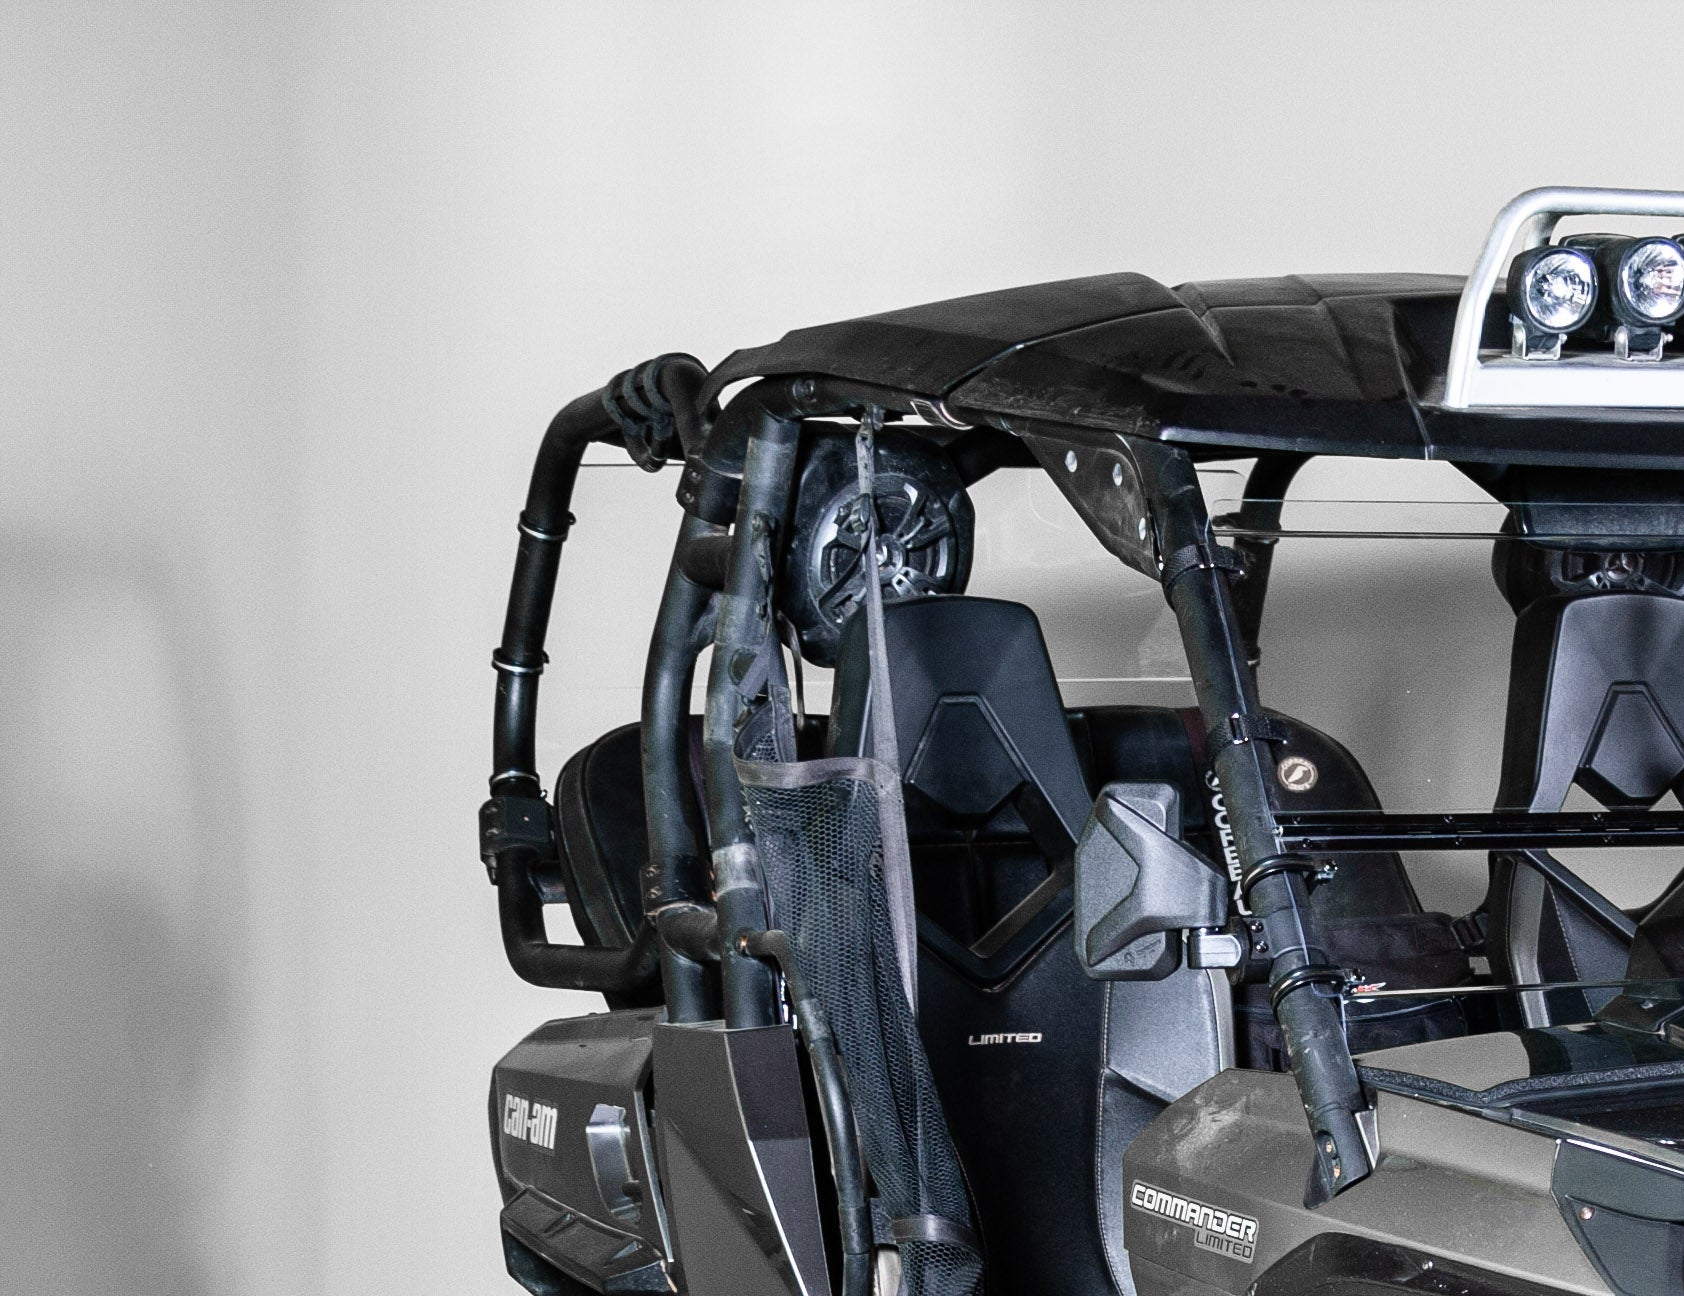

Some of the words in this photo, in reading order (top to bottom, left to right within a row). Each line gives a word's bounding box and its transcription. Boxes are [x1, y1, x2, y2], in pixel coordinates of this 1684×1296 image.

[968, 1032, 1043, 1046] LIMITED
[503, 1093, 558, 1150] can-am
[1131, 1183, 1258, 1244] COMMANDER
[1196, 1233, 1254, 1260] LIMITED
